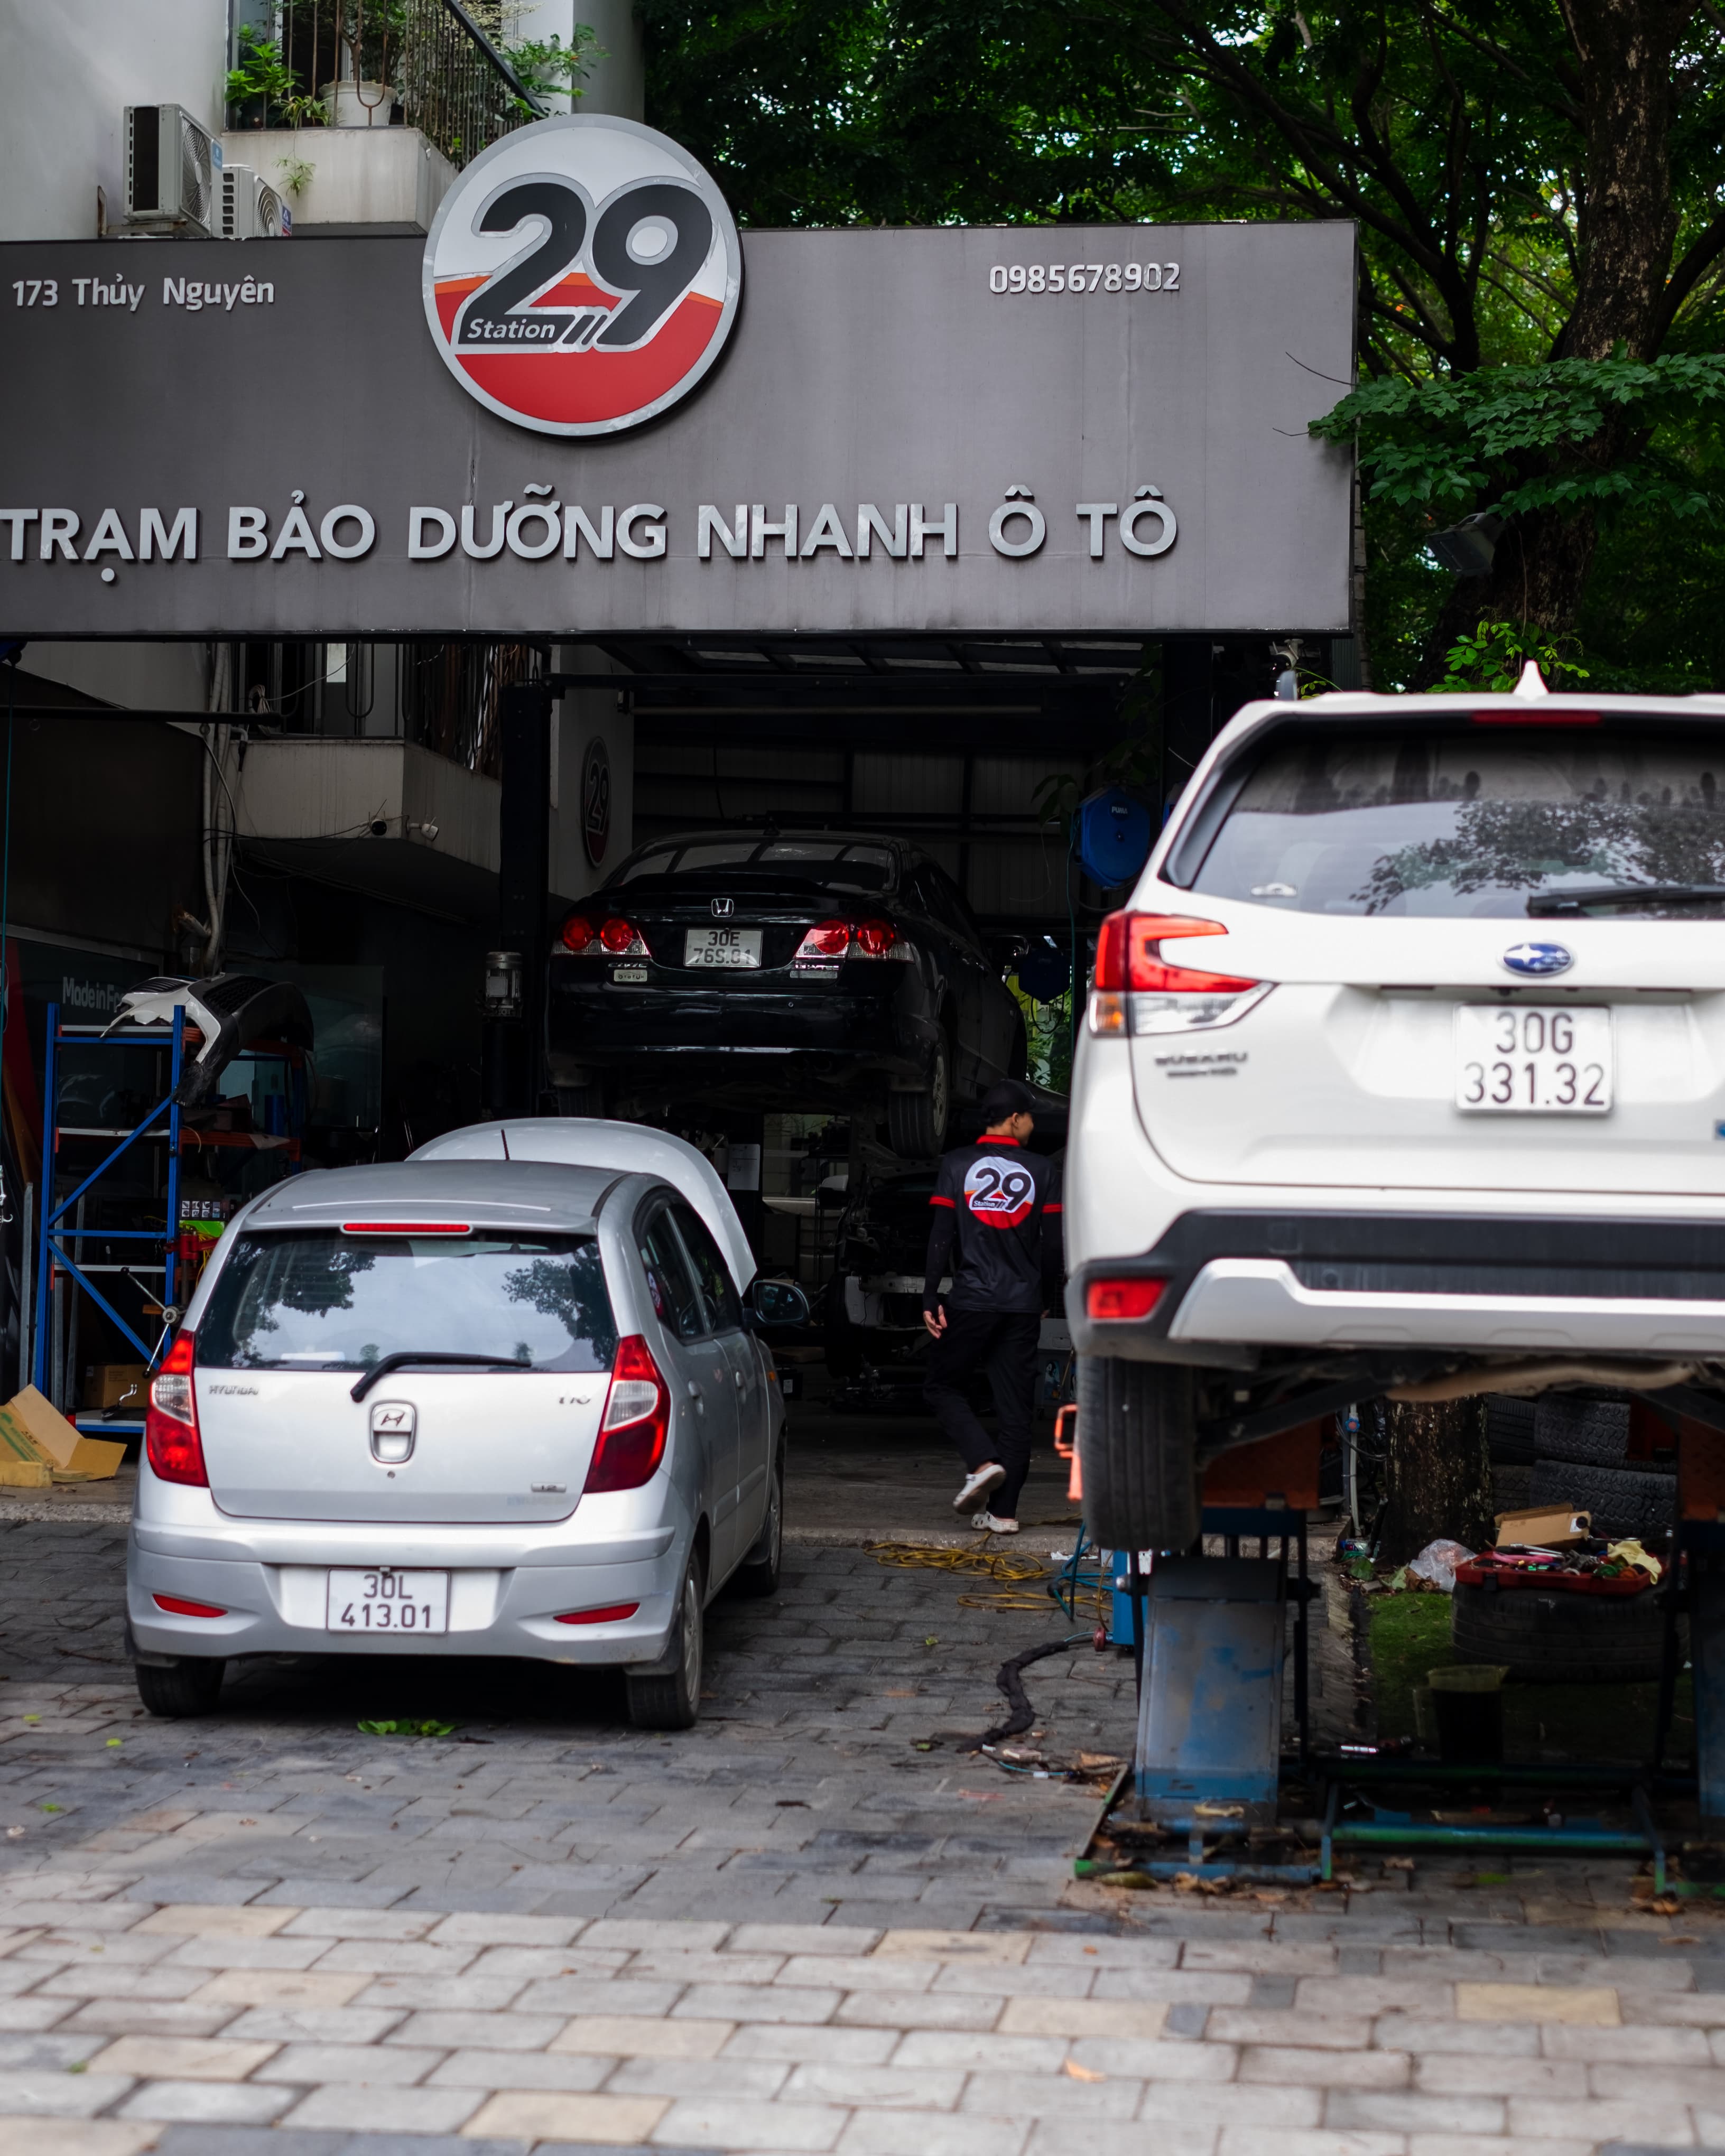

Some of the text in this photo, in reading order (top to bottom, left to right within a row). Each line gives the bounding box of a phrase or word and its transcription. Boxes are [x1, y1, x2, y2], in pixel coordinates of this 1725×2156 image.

[458, 182, 713, 345] 29
[989, 263, 1180, 293] 0985678902
[13, 273, 275, 312] 173 Thủy Nguyên
[467, 319, 555, 339] Station
[0, 483, 1177, 582] TRẠM BẢO DƯỠNG NHANH Ô TÔ
[587, 761, 609, 833] 29
[708, 931, 740, 946] 30E
[1496, 1011, 1573, 1054] 30G
[1464, 1062, 1605, 1105] 331.32
[972, 1167, 1032, 1211] 29
[363, 1574, 413, 1599] 30L
[341, 1603, 431, 1629] 413.01
